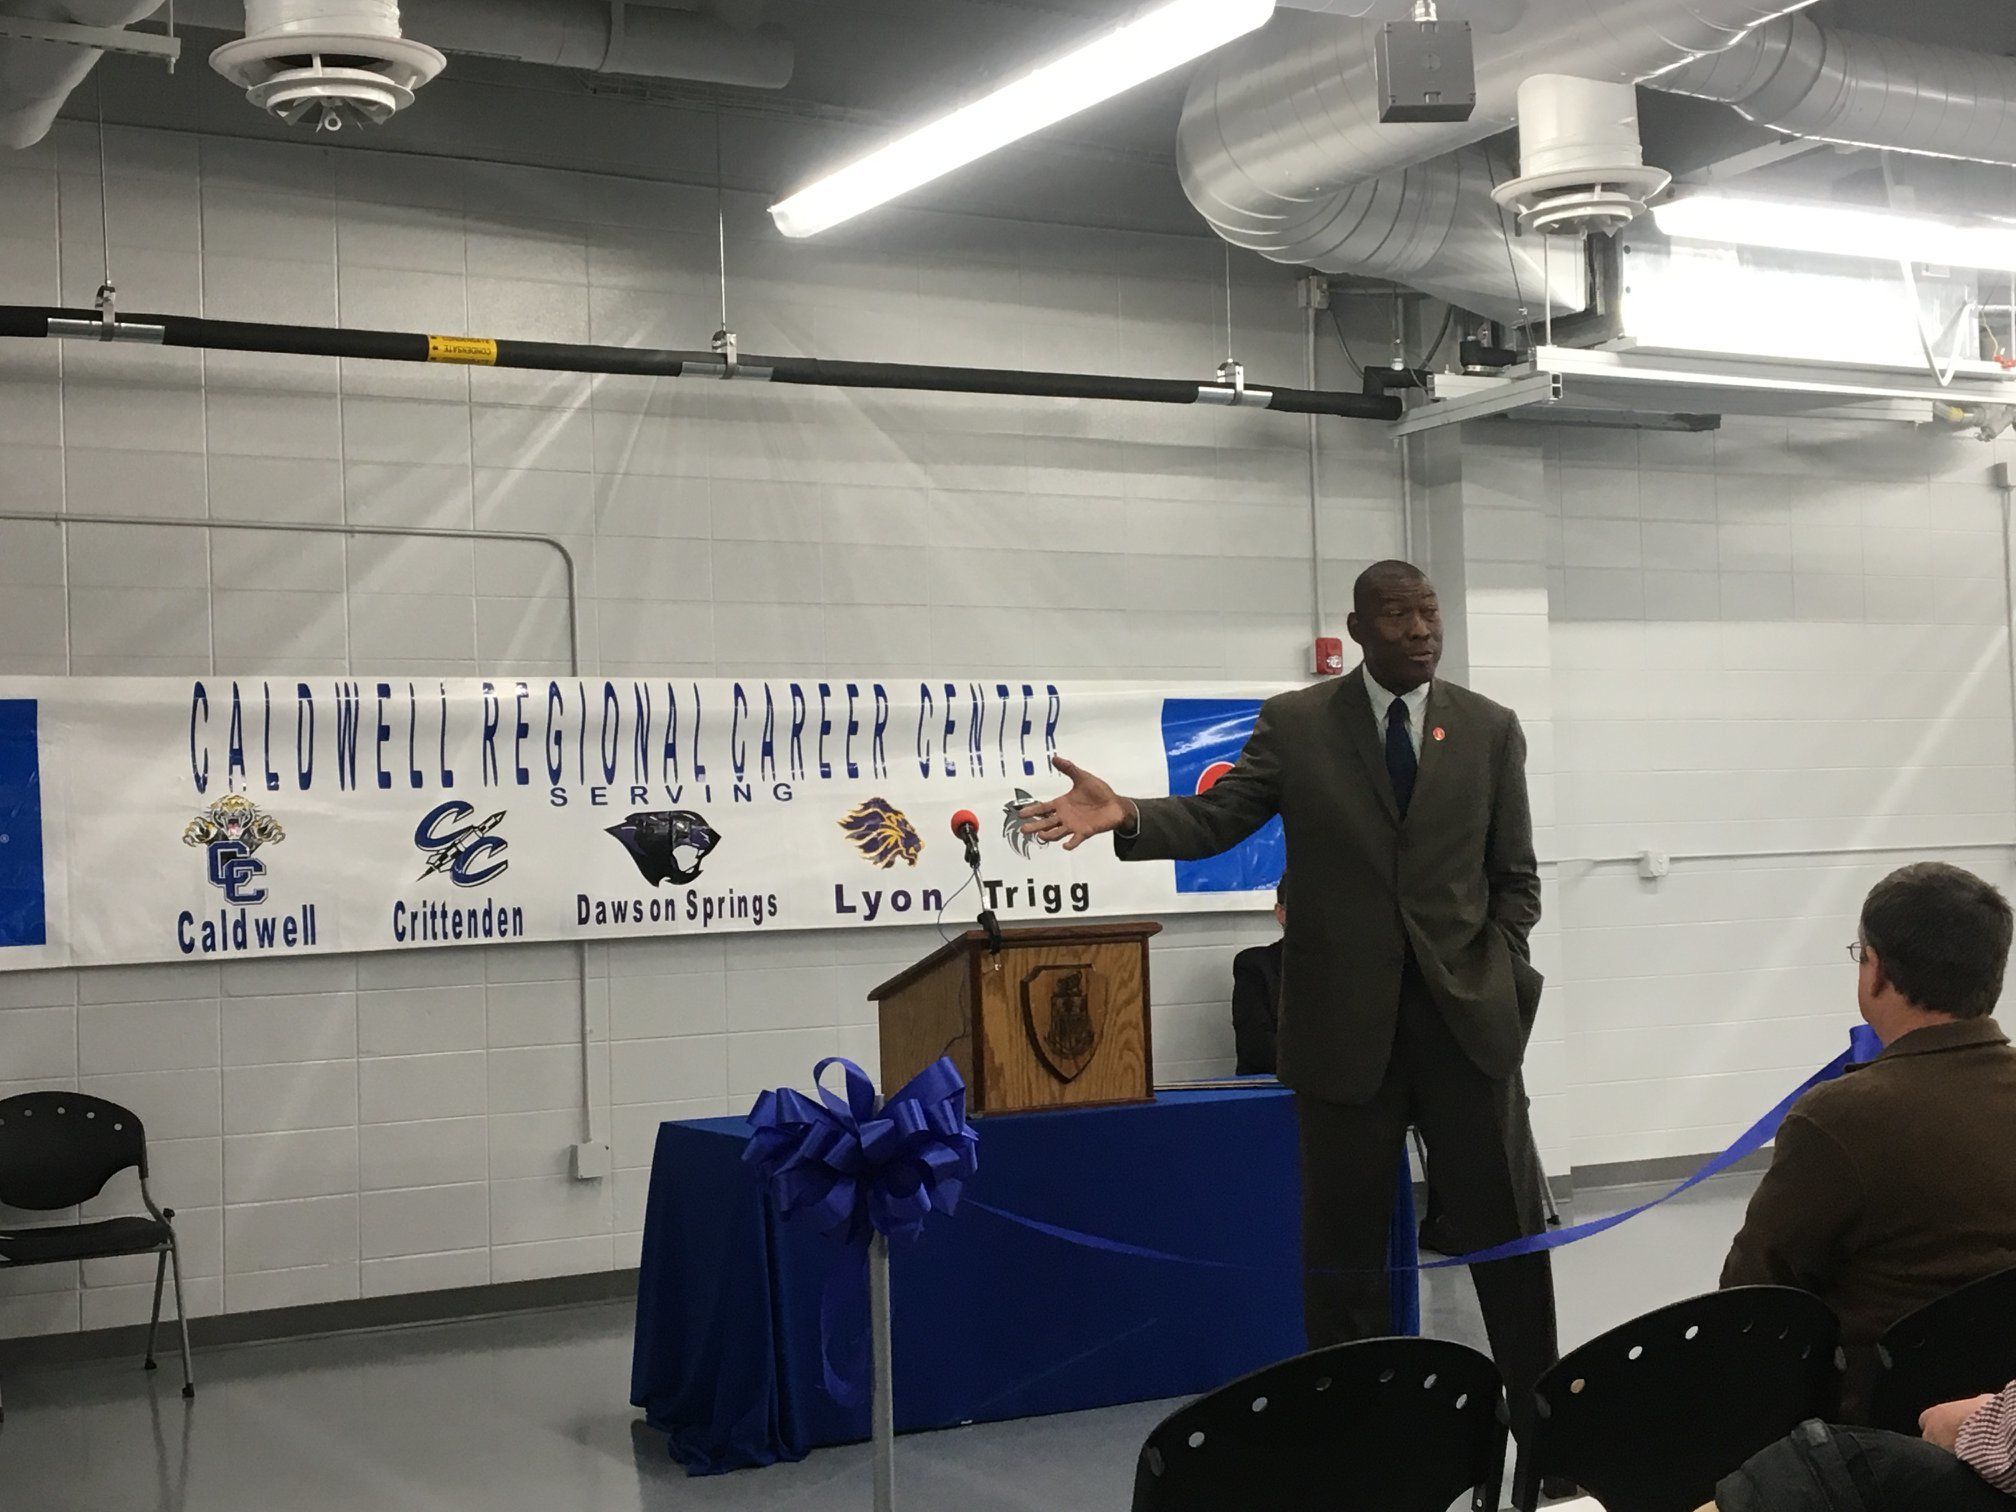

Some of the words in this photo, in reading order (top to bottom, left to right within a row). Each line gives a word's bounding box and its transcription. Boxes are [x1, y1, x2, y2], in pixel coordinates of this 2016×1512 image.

[190, 681, 454, 794] CALDWELL
[482, 680, 706, 787] REGIONAL
[731, 682, 889, 782] CAREER
[916, 682, 1061, 778] CENTER
[550, 783, 793, 807] SERVING
[577, 894, 676, 926] Dawson
[686, 888, 778, 927] Springs
[834, 883, 943, 922] Lyon
[983, 878, 1090, 913] Trigg
[177, 904, 318, 954] Caldwell
[393, 897, 524, 943] Crittenden
